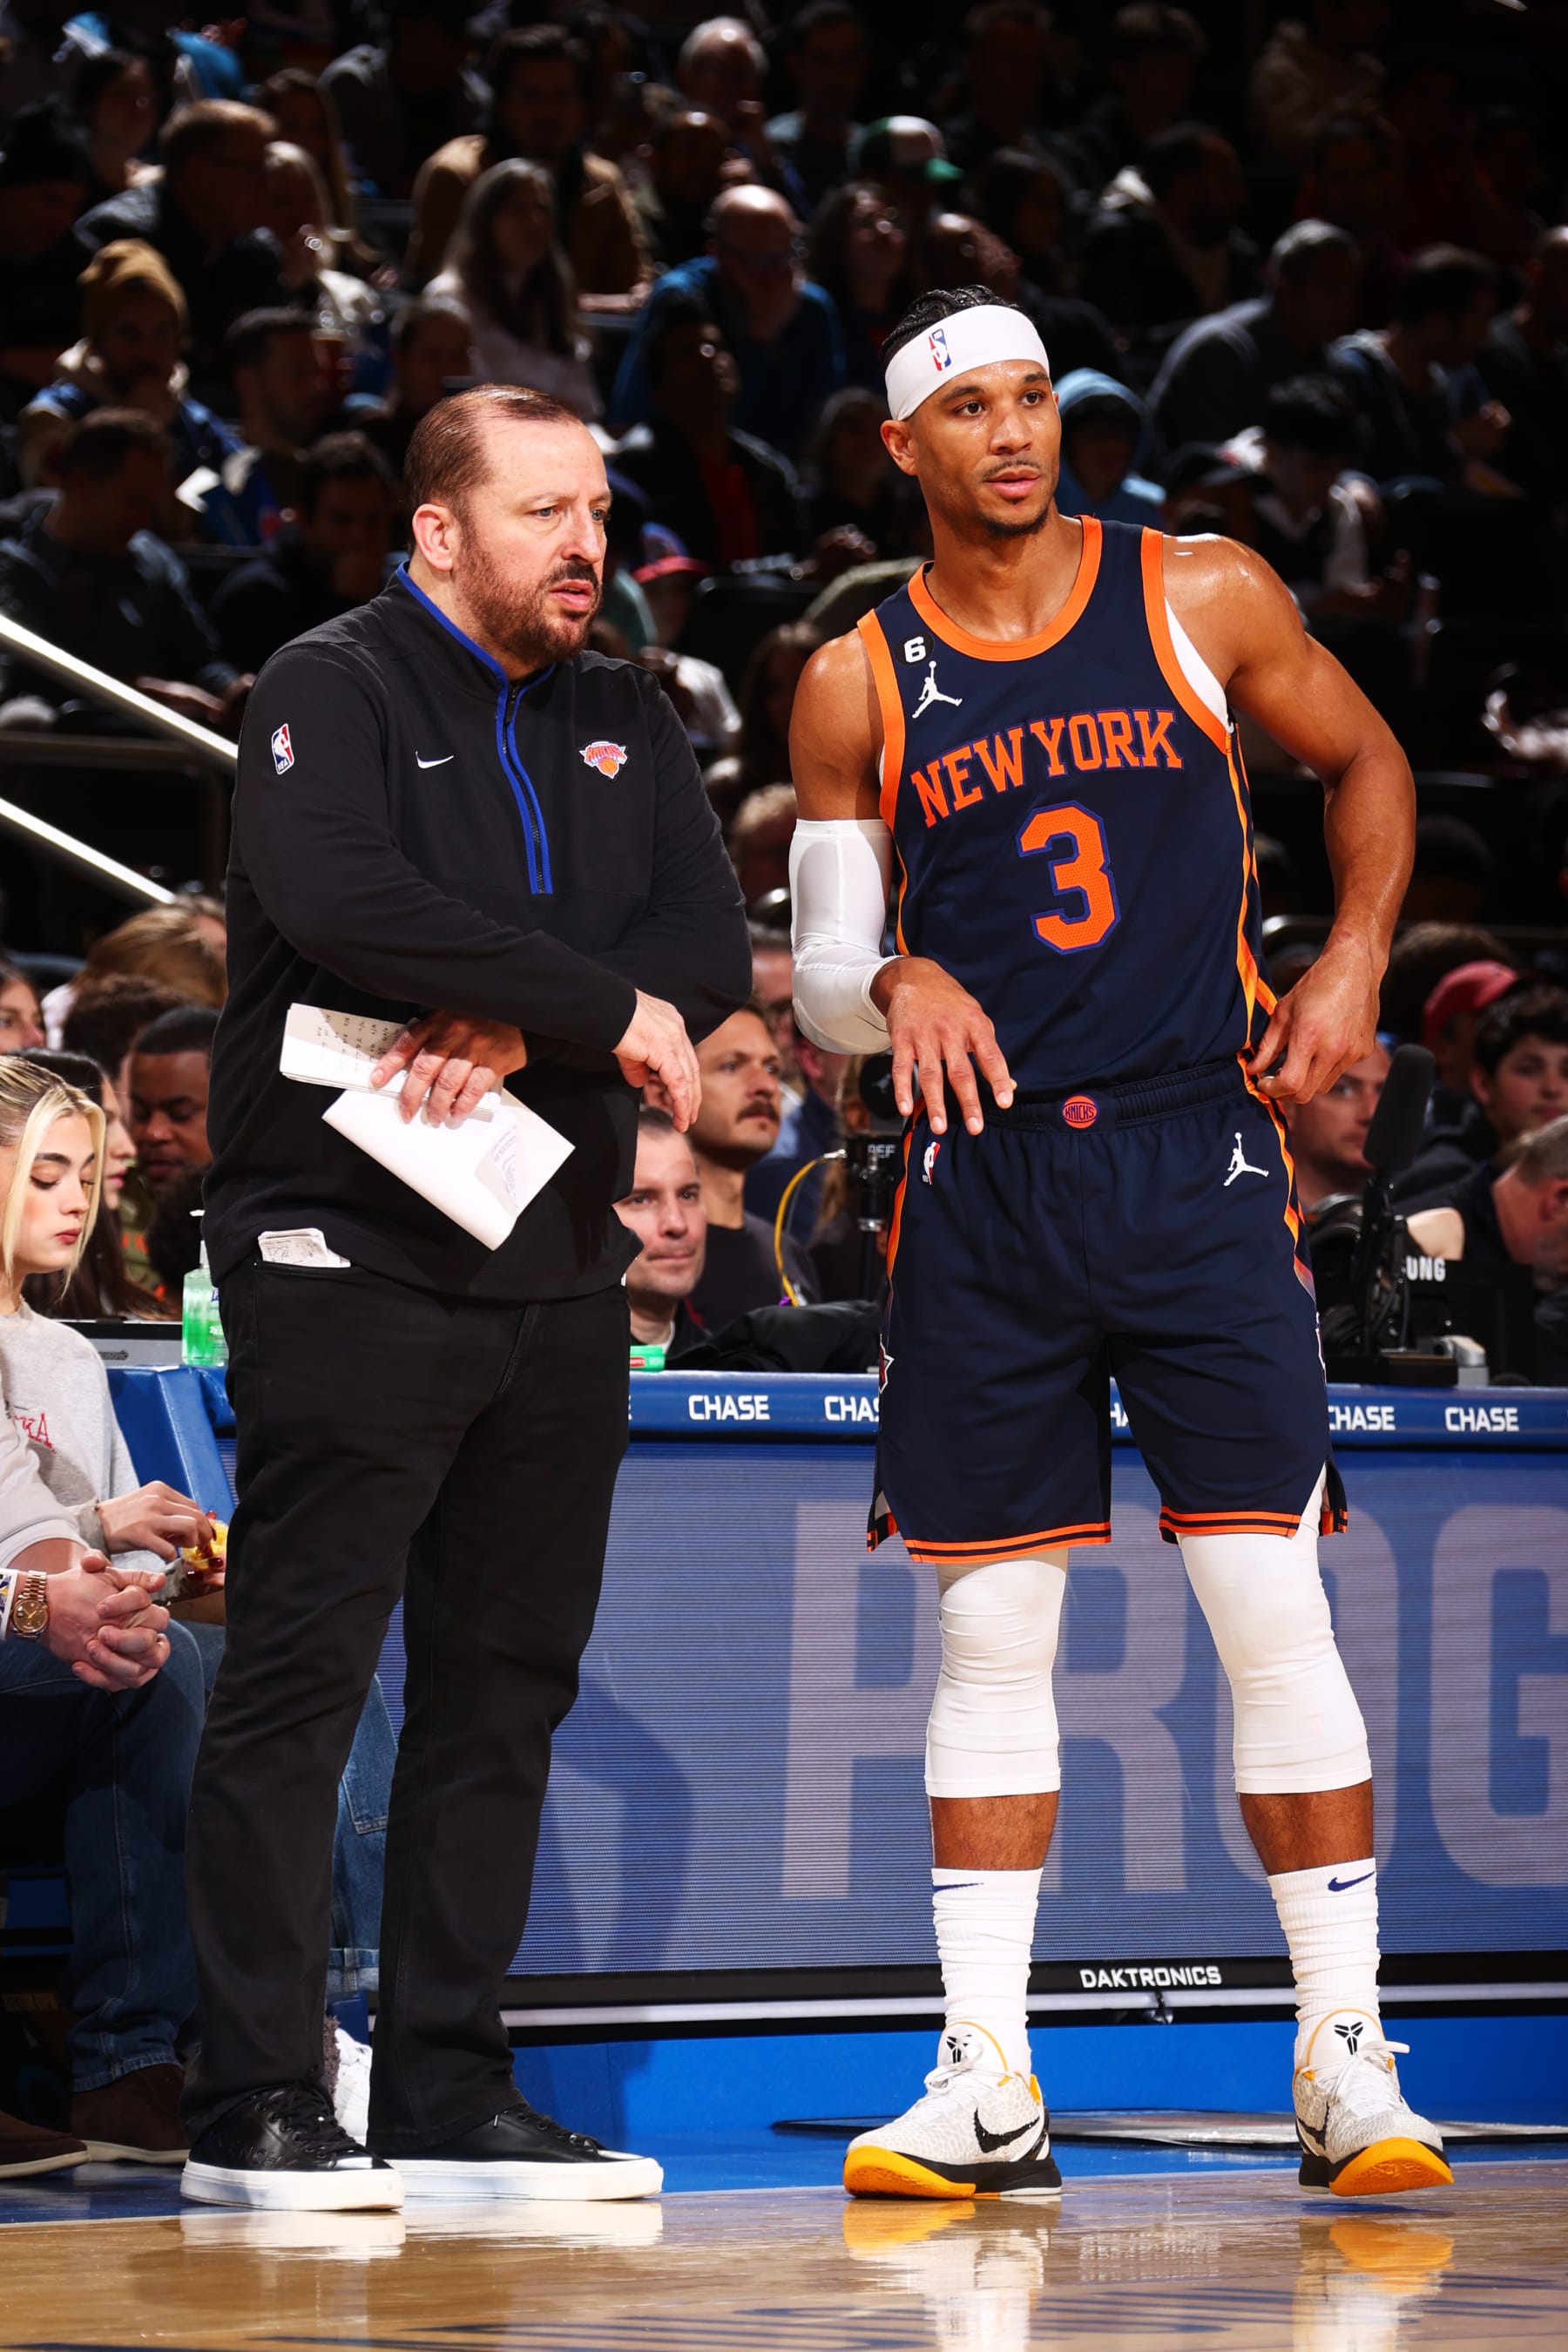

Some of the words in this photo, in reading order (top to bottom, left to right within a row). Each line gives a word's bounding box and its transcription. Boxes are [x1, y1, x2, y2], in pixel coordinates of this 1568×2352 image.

[903, 636, 927, 663] 6
[909, 725, 1025, 829] NEW
[1028, 708, 1185, 778] YORK
[1016, 800, 1121, 955] 3
[1064, 1104, 1095, 1121] KNICKS
[688, 1394, 771, 1421] CHASE
[824, 1396, 879, 1422] CHA
[1443, 1407, 1520, 1432] CHASE
[1079, 1965, 1222, 1989] DAKTRONICS
